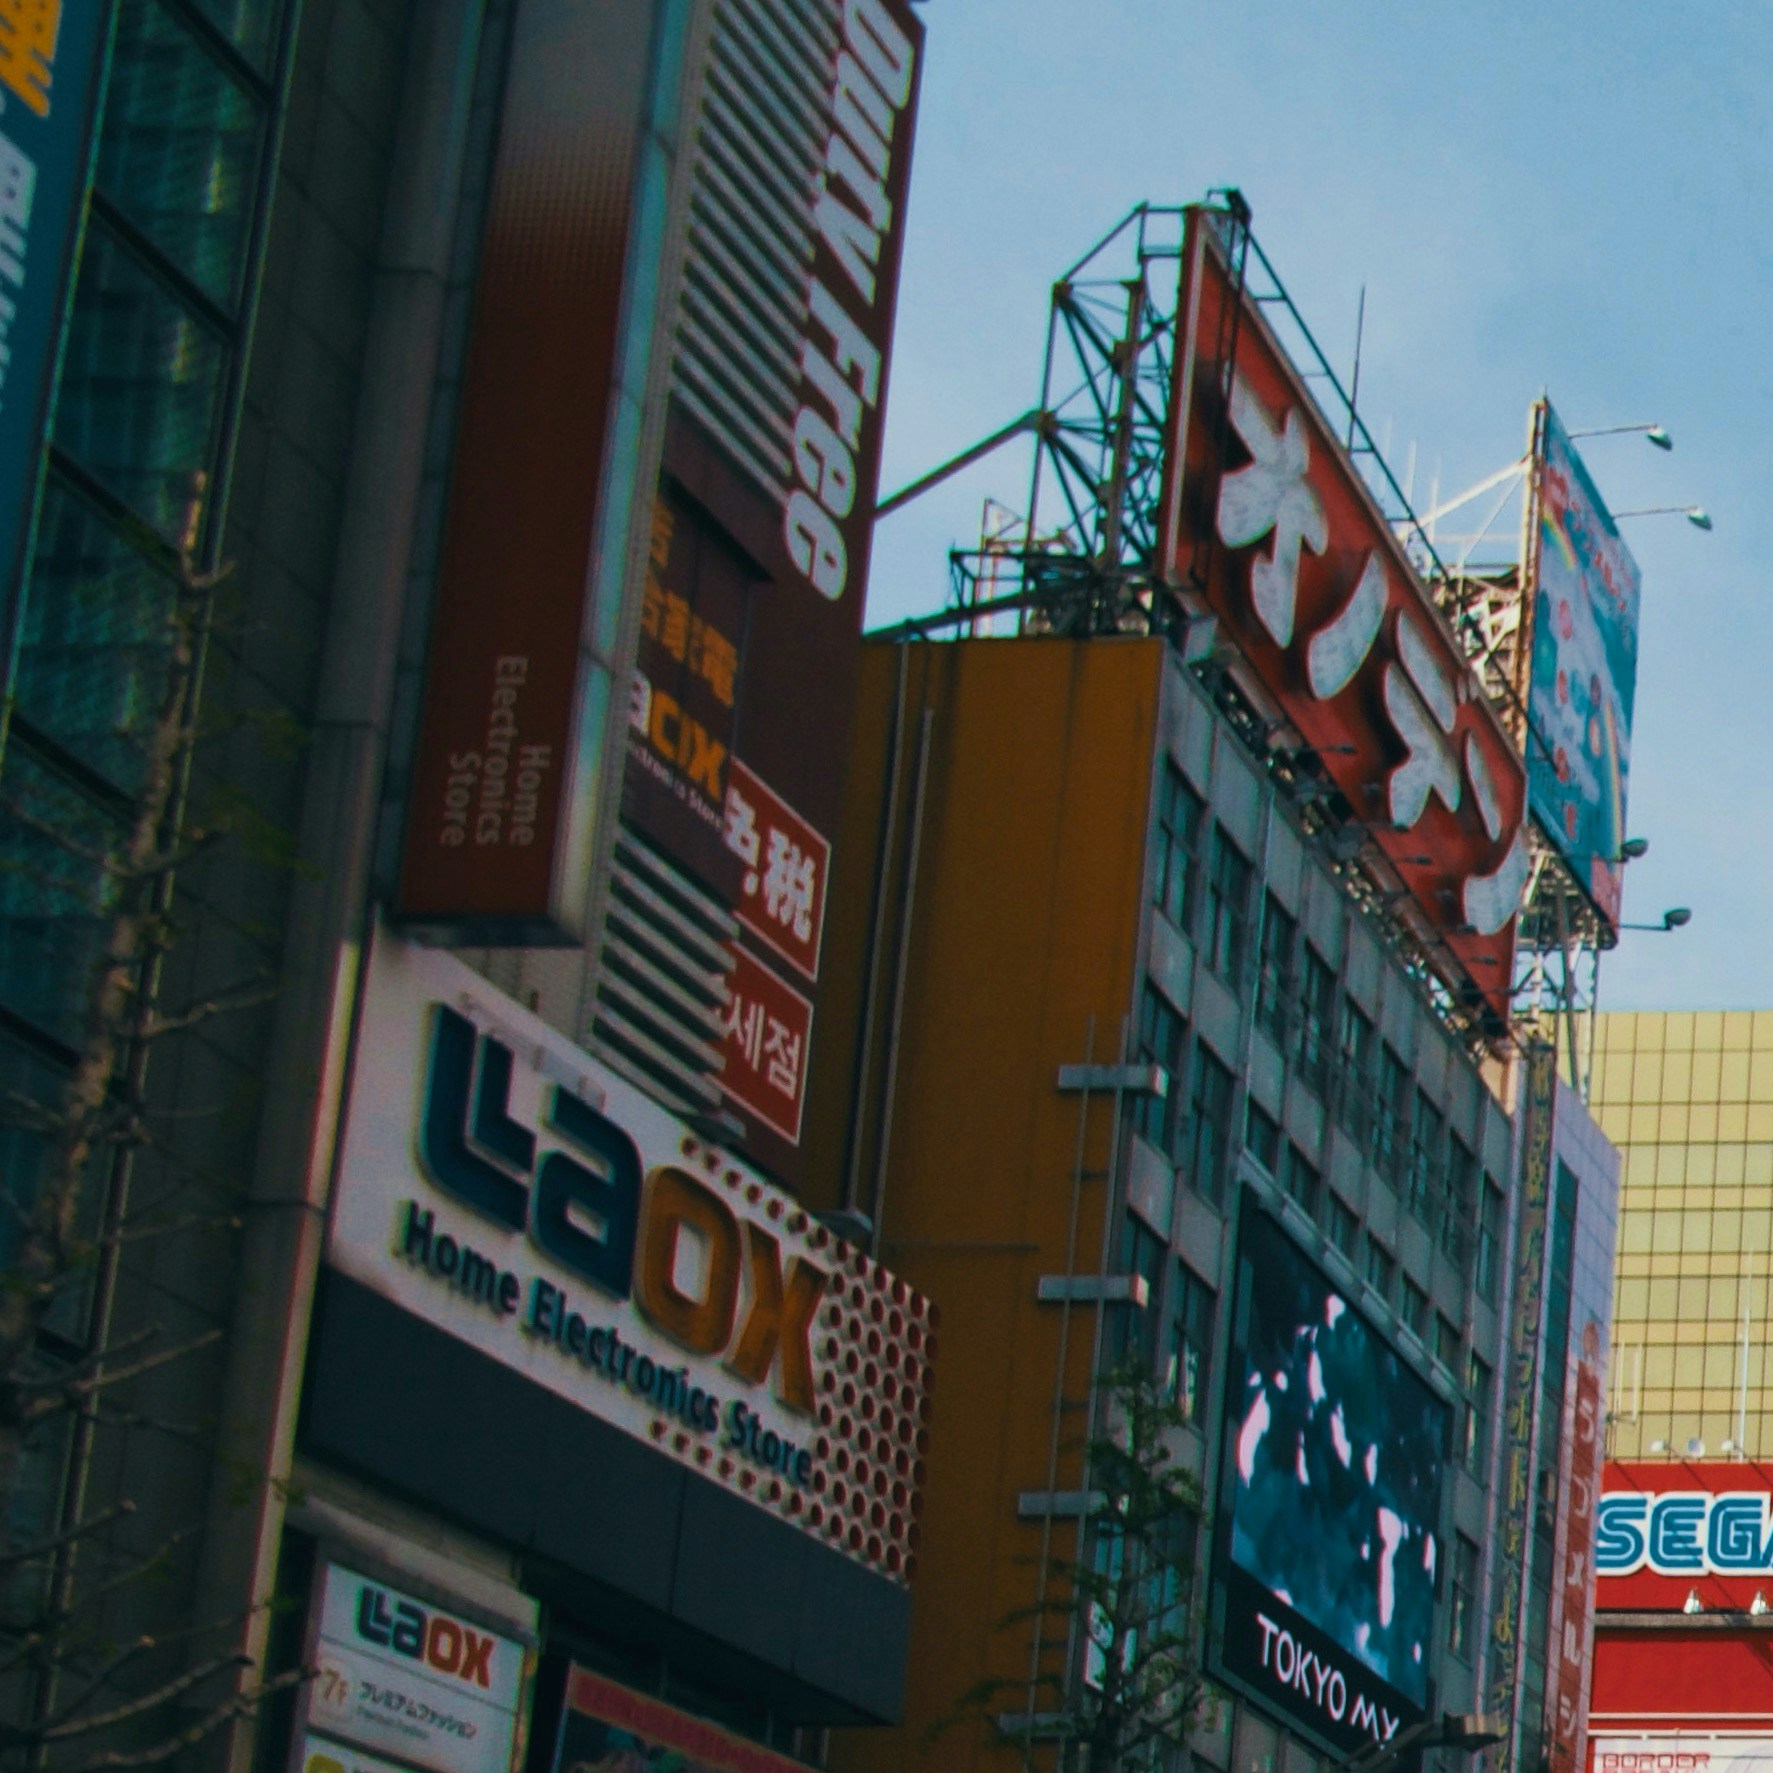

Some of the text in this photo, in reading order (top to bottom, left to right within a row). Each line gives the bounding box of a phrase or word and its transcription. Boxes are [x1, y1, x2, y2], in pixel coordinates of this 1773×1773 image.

[782, 278, 881, 601] Free
[439, 752, 467, 849] Store
[474, 654, 530, 848] Electronics
[508, 743, 552, 848] Home
[402, 1201, 812, 1485] Home Electronics Store
[1256, 1612, 1346, 1722] TOKYO
